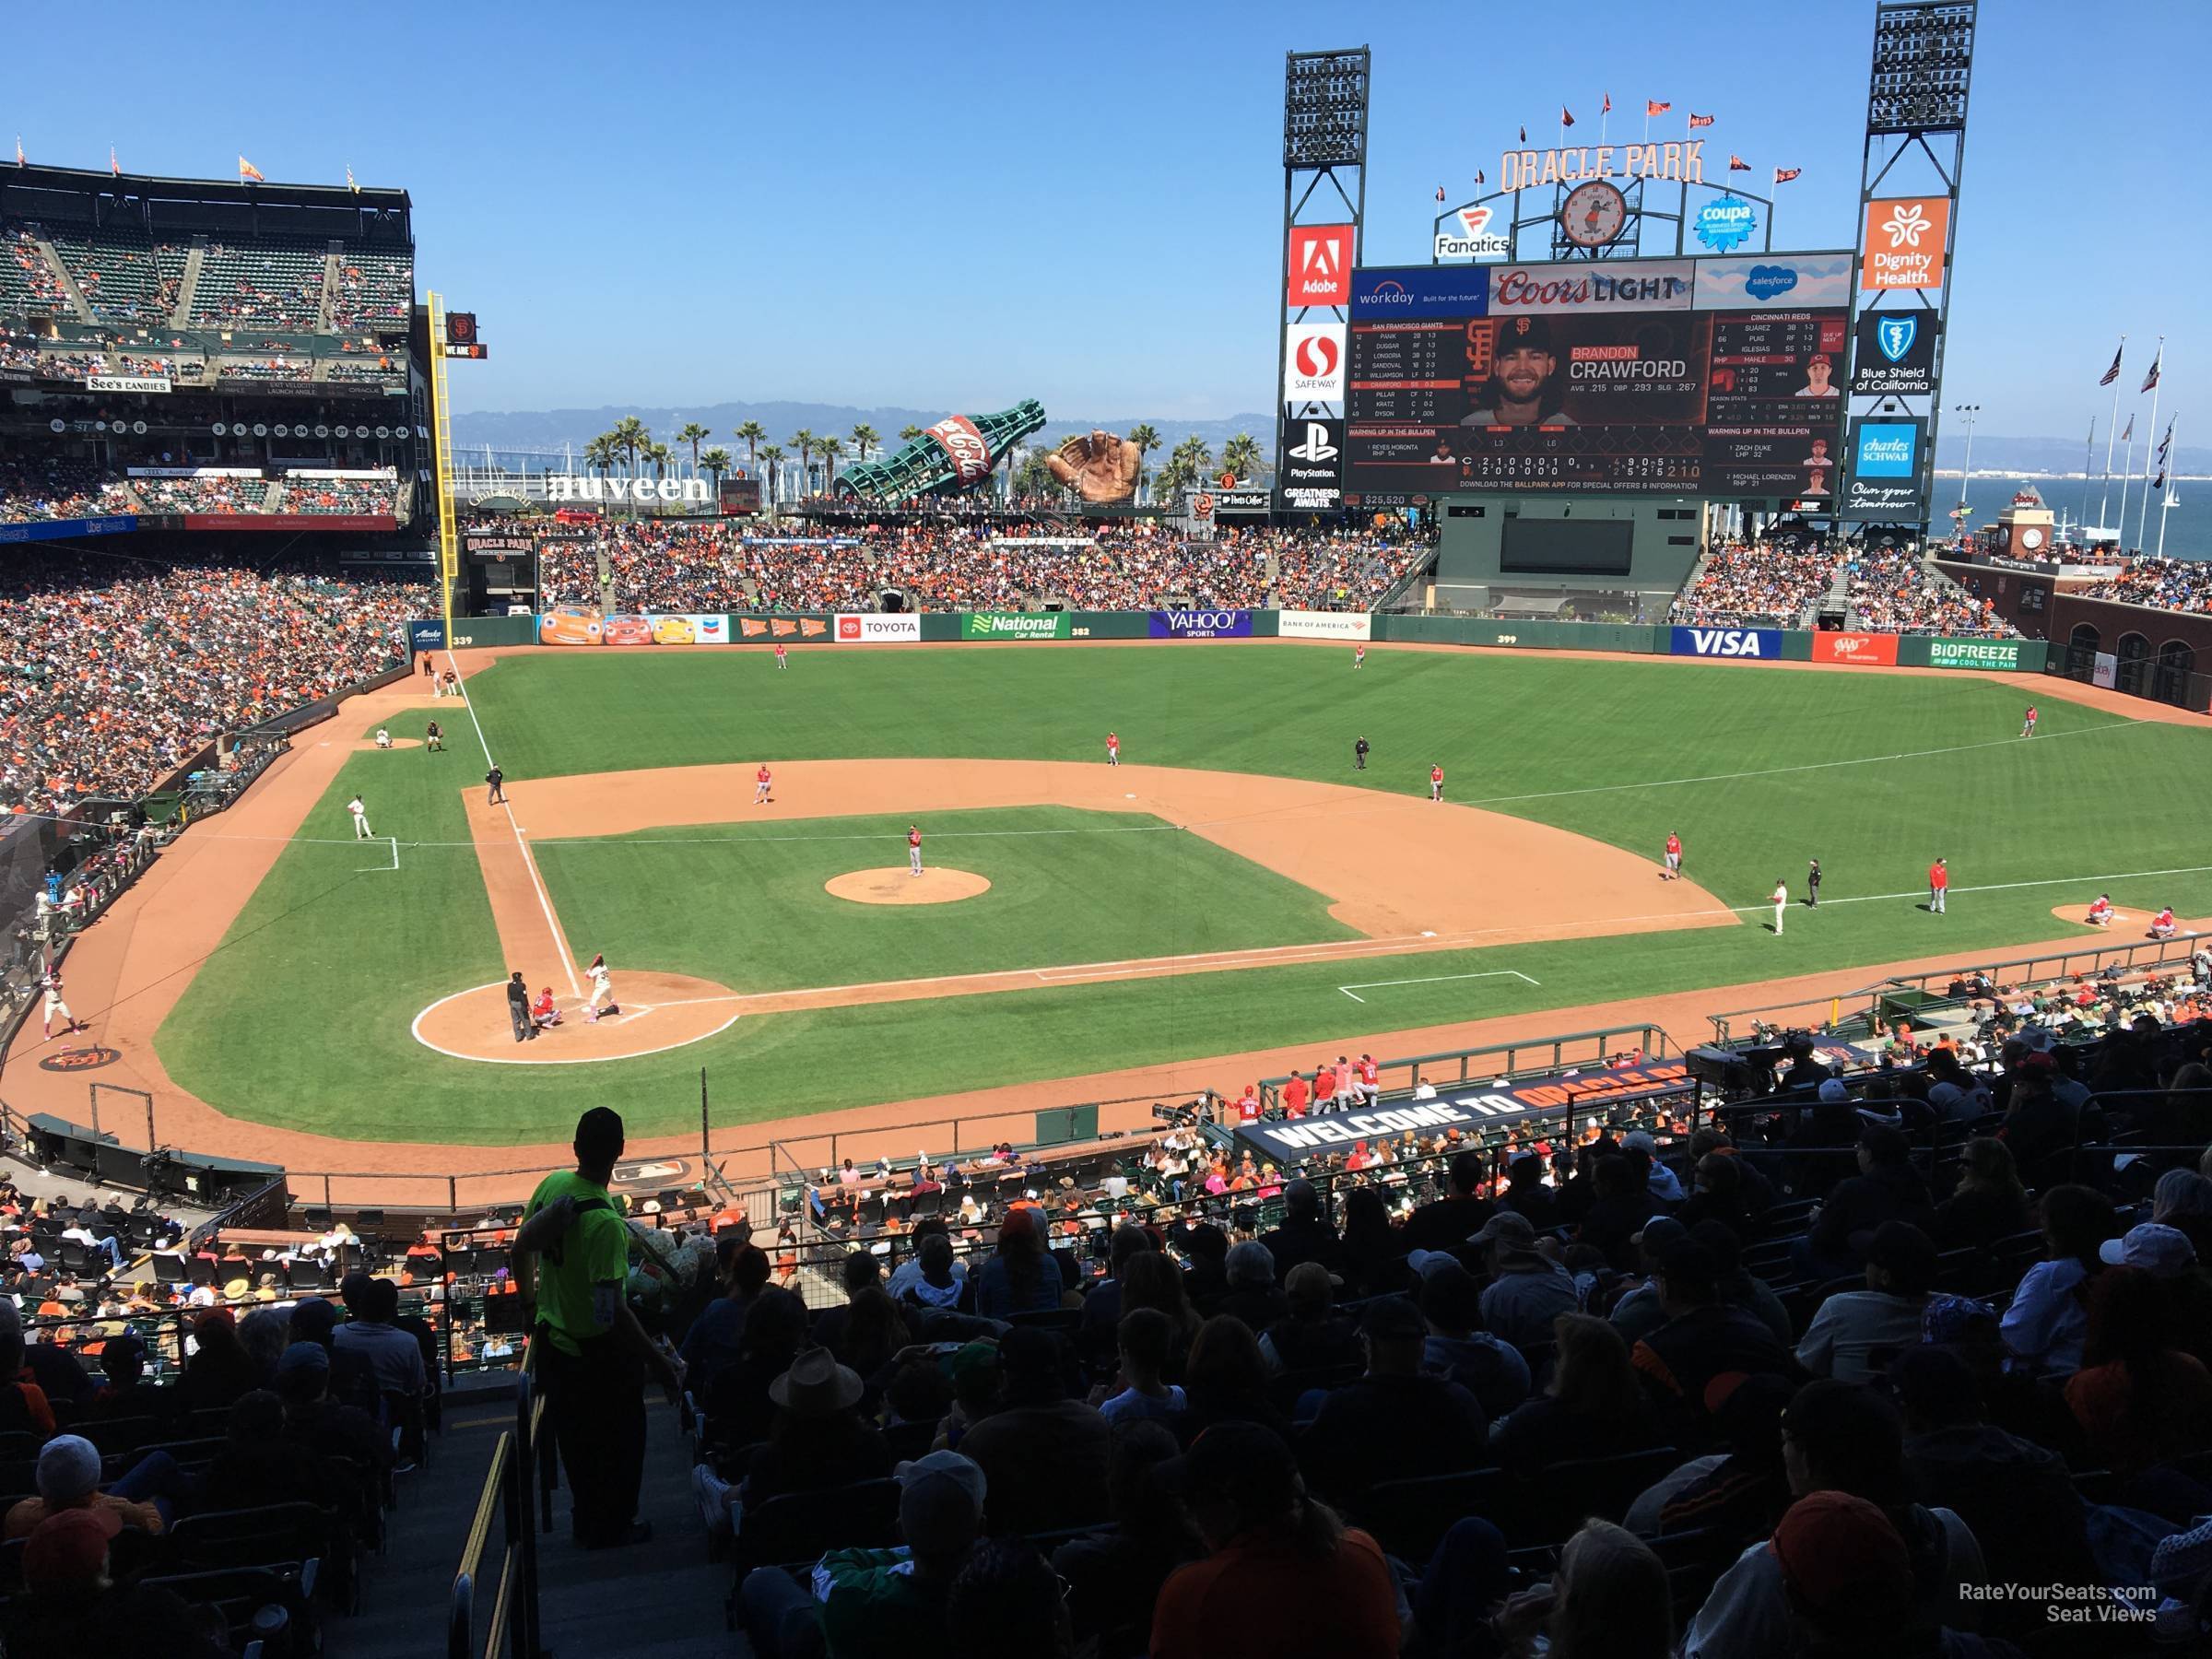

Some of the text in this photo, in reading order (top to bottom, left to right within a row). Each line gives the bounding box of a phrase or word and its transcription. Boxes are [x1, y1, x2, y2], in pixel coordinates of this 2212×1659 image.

[1501, 140, 1704, 194] ORACLE PARK
[1703, 206, 1750, 223] coupa
[1439, 236, 1510, 255] Fanatics
[1875, 252, 1932, 270] Dignity
[1303, 280, 1337, 293] Adobe
[1752, 276, 1794, 286] salesforce
[1498, 271, 1678, 305] Coors LIGHT
[1360, 291, 1414, 305] workday
[446, 347, 455, 355] WE
[457, 347, 469, 355] ARE
[1572, 347, 1637, 359] BRANDON
[1571, 361, 1686, 379] CRAWFORD
[1862, 368, 1924, 378] Blue Shield
[92, 378, 166, 391] See's CANDIES
[1295, 380, 1336, 389] SAFEWAY
[1632, 383, 1652, 392] .293
[1677, 383, 1696, 392] .267
[1856, 380, 1928, 391] of California
[1864, 439, 1910, 452] charles
[1852, 482, 1914, 501] Own your
[1366, 496, 1405, 504] $25,520
[1849, 497, 1915, 508] tomorrow
[87, 521, 101, 533] Uber
[467, 538, 533, 552] ORACLE PARK
[992, 616, 1058, 631] National
[1167, 611, 1235, 629] YAHOO!
[415, 629, 442, 638] Alaska
[866, 623, 916, 632] TOYOTA
[453, 636, 472, 645] 339
[1030, 630, 1054, 639] Rental
[1498, 635, 1517, 644] 399
[1688, 629, 1760, 656] VISA
[1836, 639, 1856, 651] AAA
[1264, 1102, 1472, 1148] WELCOME
[1455, 1094, 1525, 1116] TO
